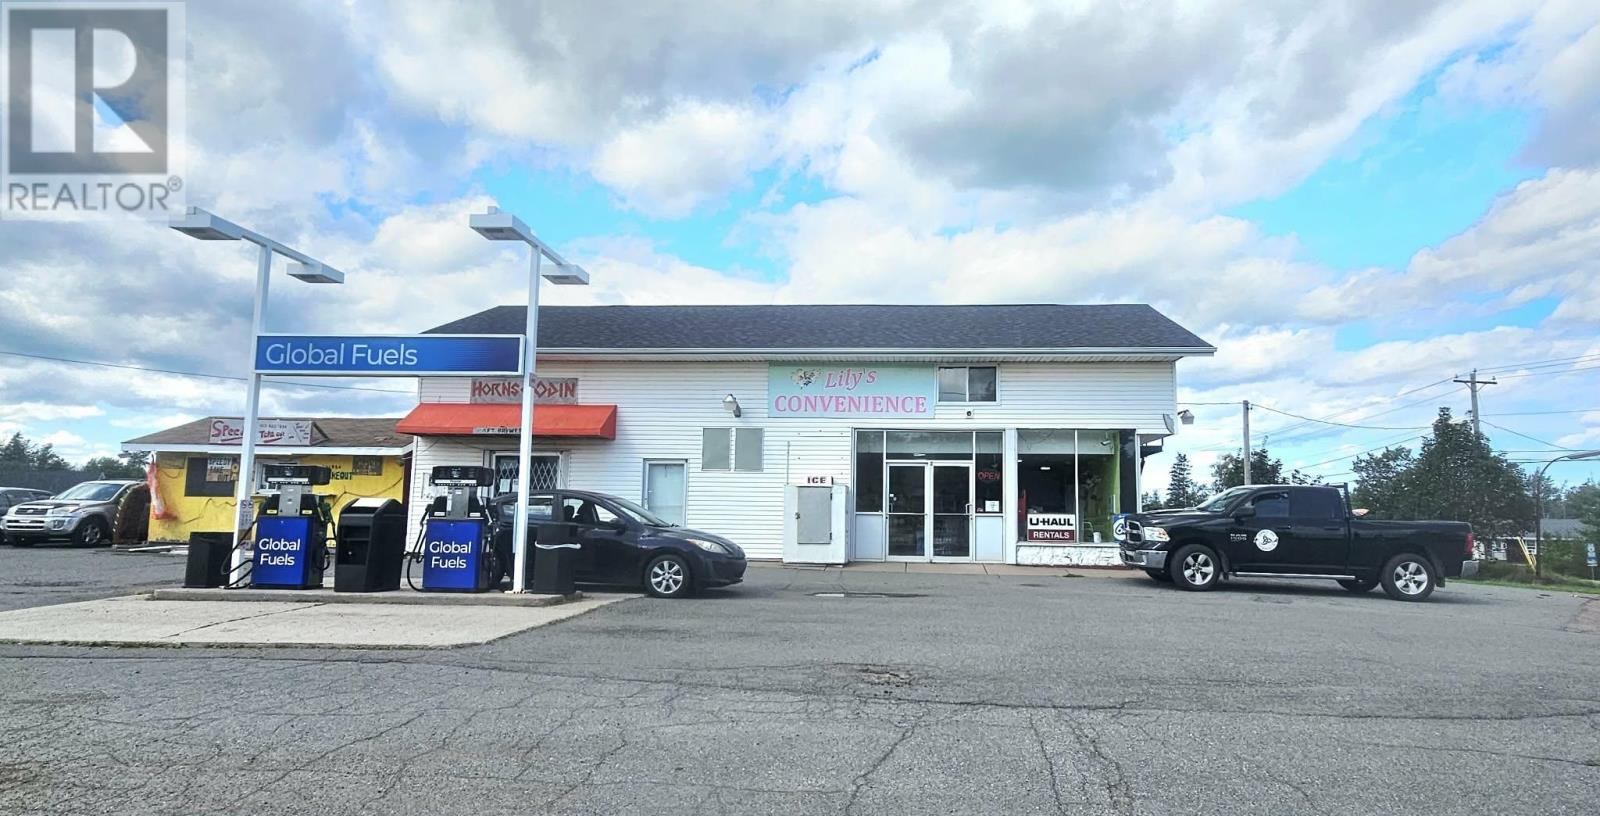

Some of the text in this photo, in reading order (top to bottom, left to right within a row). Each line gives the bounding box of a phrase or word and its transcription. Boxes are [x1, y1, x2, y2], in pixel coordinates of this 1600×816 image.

[265, 343, 418, 366] Global Fuels
[825, 368, 877, 390] Lily's
[472, 380, 576, 398] HORNS ODIN
[774, 395, 927, 413] CONVENIENCE
[807, 476, 827, 485] ICE
[977, 471, 1001, 481] OPEN
[1029, 517, 1074, 527] U-HAUL
[1033, 531, 1070, 539] RENTALS
[258, 538, 301, 551] Global
[429, 541, 472, 554] Global
[260, 553, 296, 566] Fuels
[431, 556, 467, 569] Fuels
